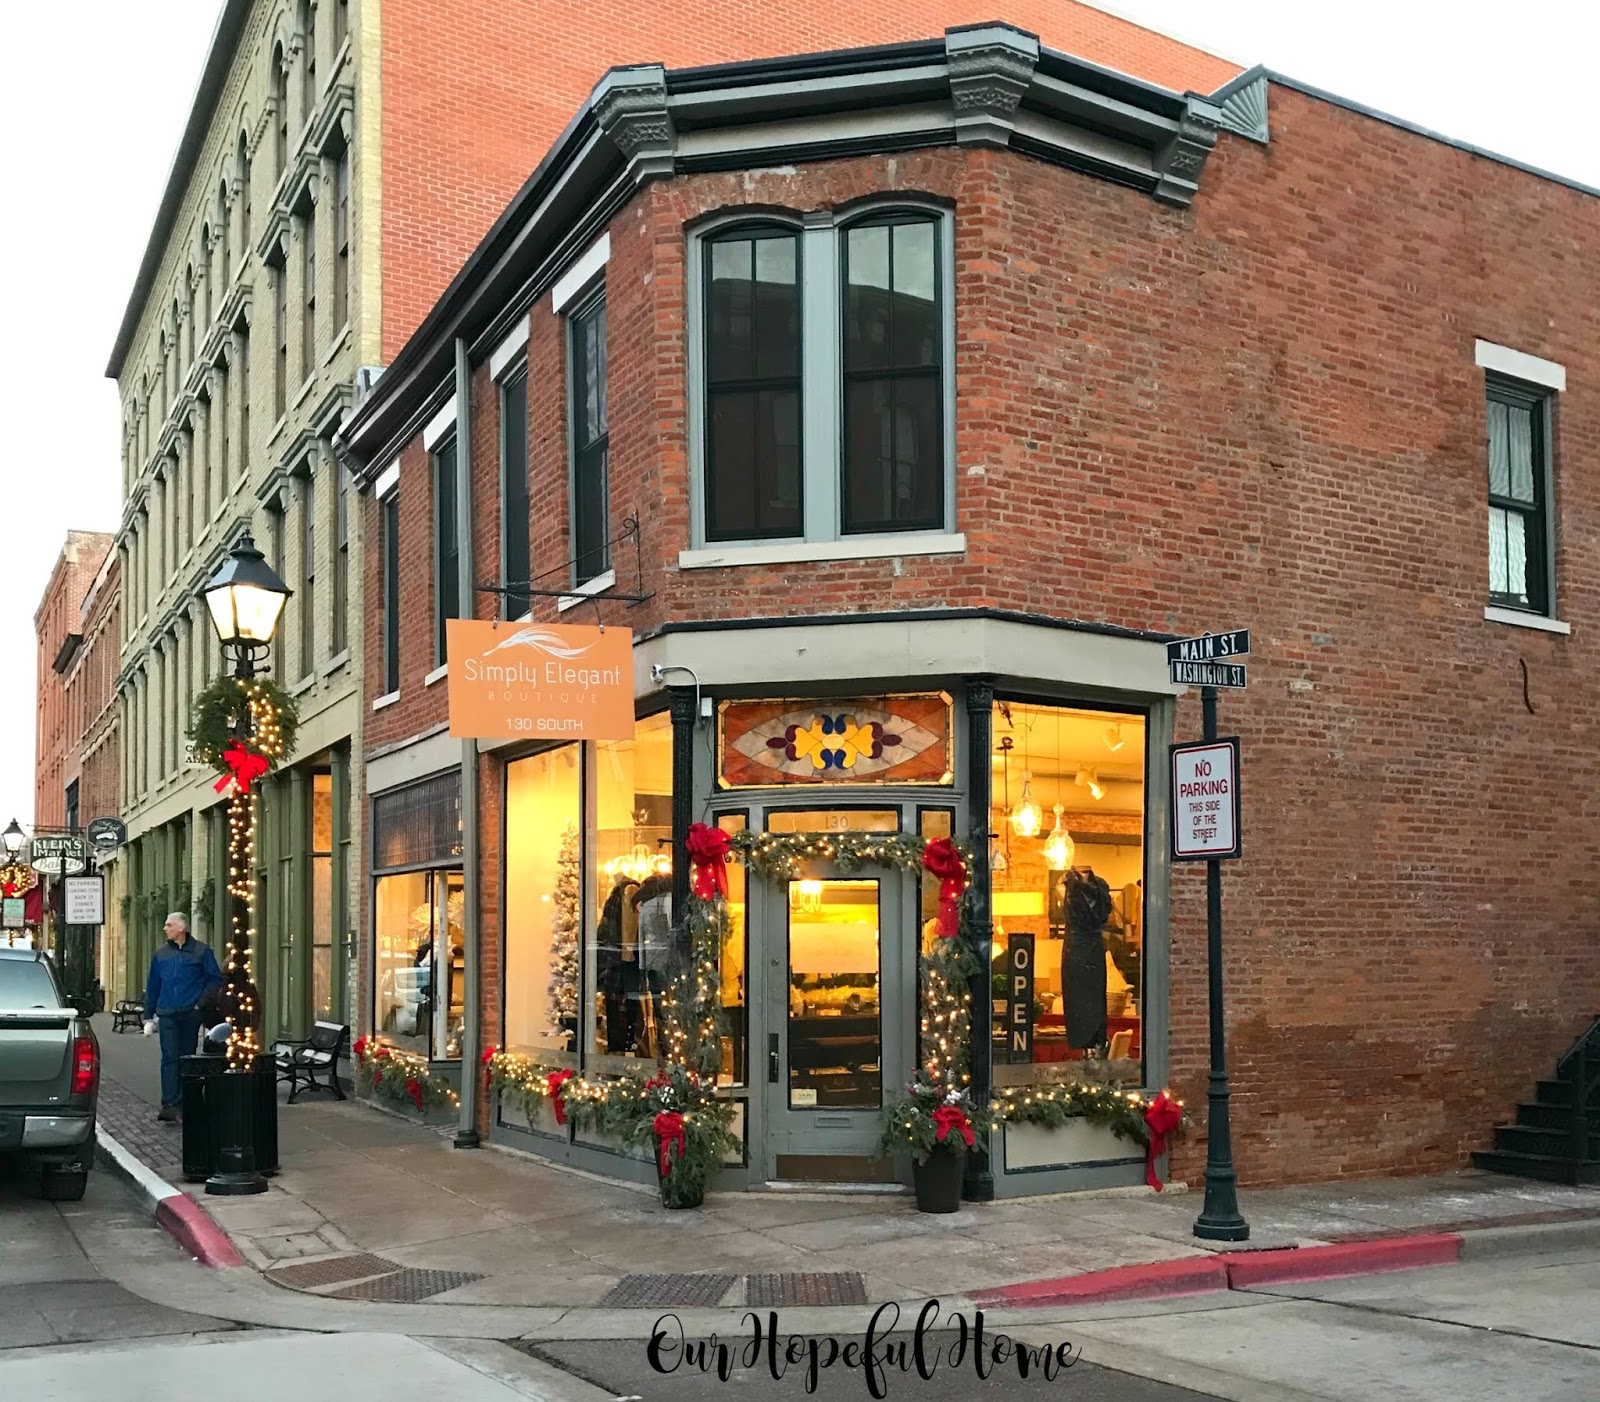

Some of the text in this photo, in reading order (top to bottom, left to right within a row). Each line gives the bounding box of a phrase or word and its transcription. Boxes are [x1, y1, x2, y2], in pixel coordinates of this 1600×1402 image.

[1180, 634, 1239, 660] MAIN ST.
[464, 658, 621, 691] Simply Elegant
[1175, 662, 1244, 686] WASHINGTON ST.
[488, 690, 598, 704] BOUTIQUE
[506, 718, 583, 731] 130 SOUTH
[1195, 761, 1212, 777] NO
[1180, 779, 1228, 798] PARKING
[1189, 800, 1220, 812] THIS SIDE
[824, 815, 849, 830] 130
[1193, 814, 1217, 826] OF THE
[1192, 827, 1217, 839] STREET
[33, 838, 83, 855] KLEIN'S
[35, 856, 82, 868] Bakry
[1013, 948, 1029, 1051] OPEN
